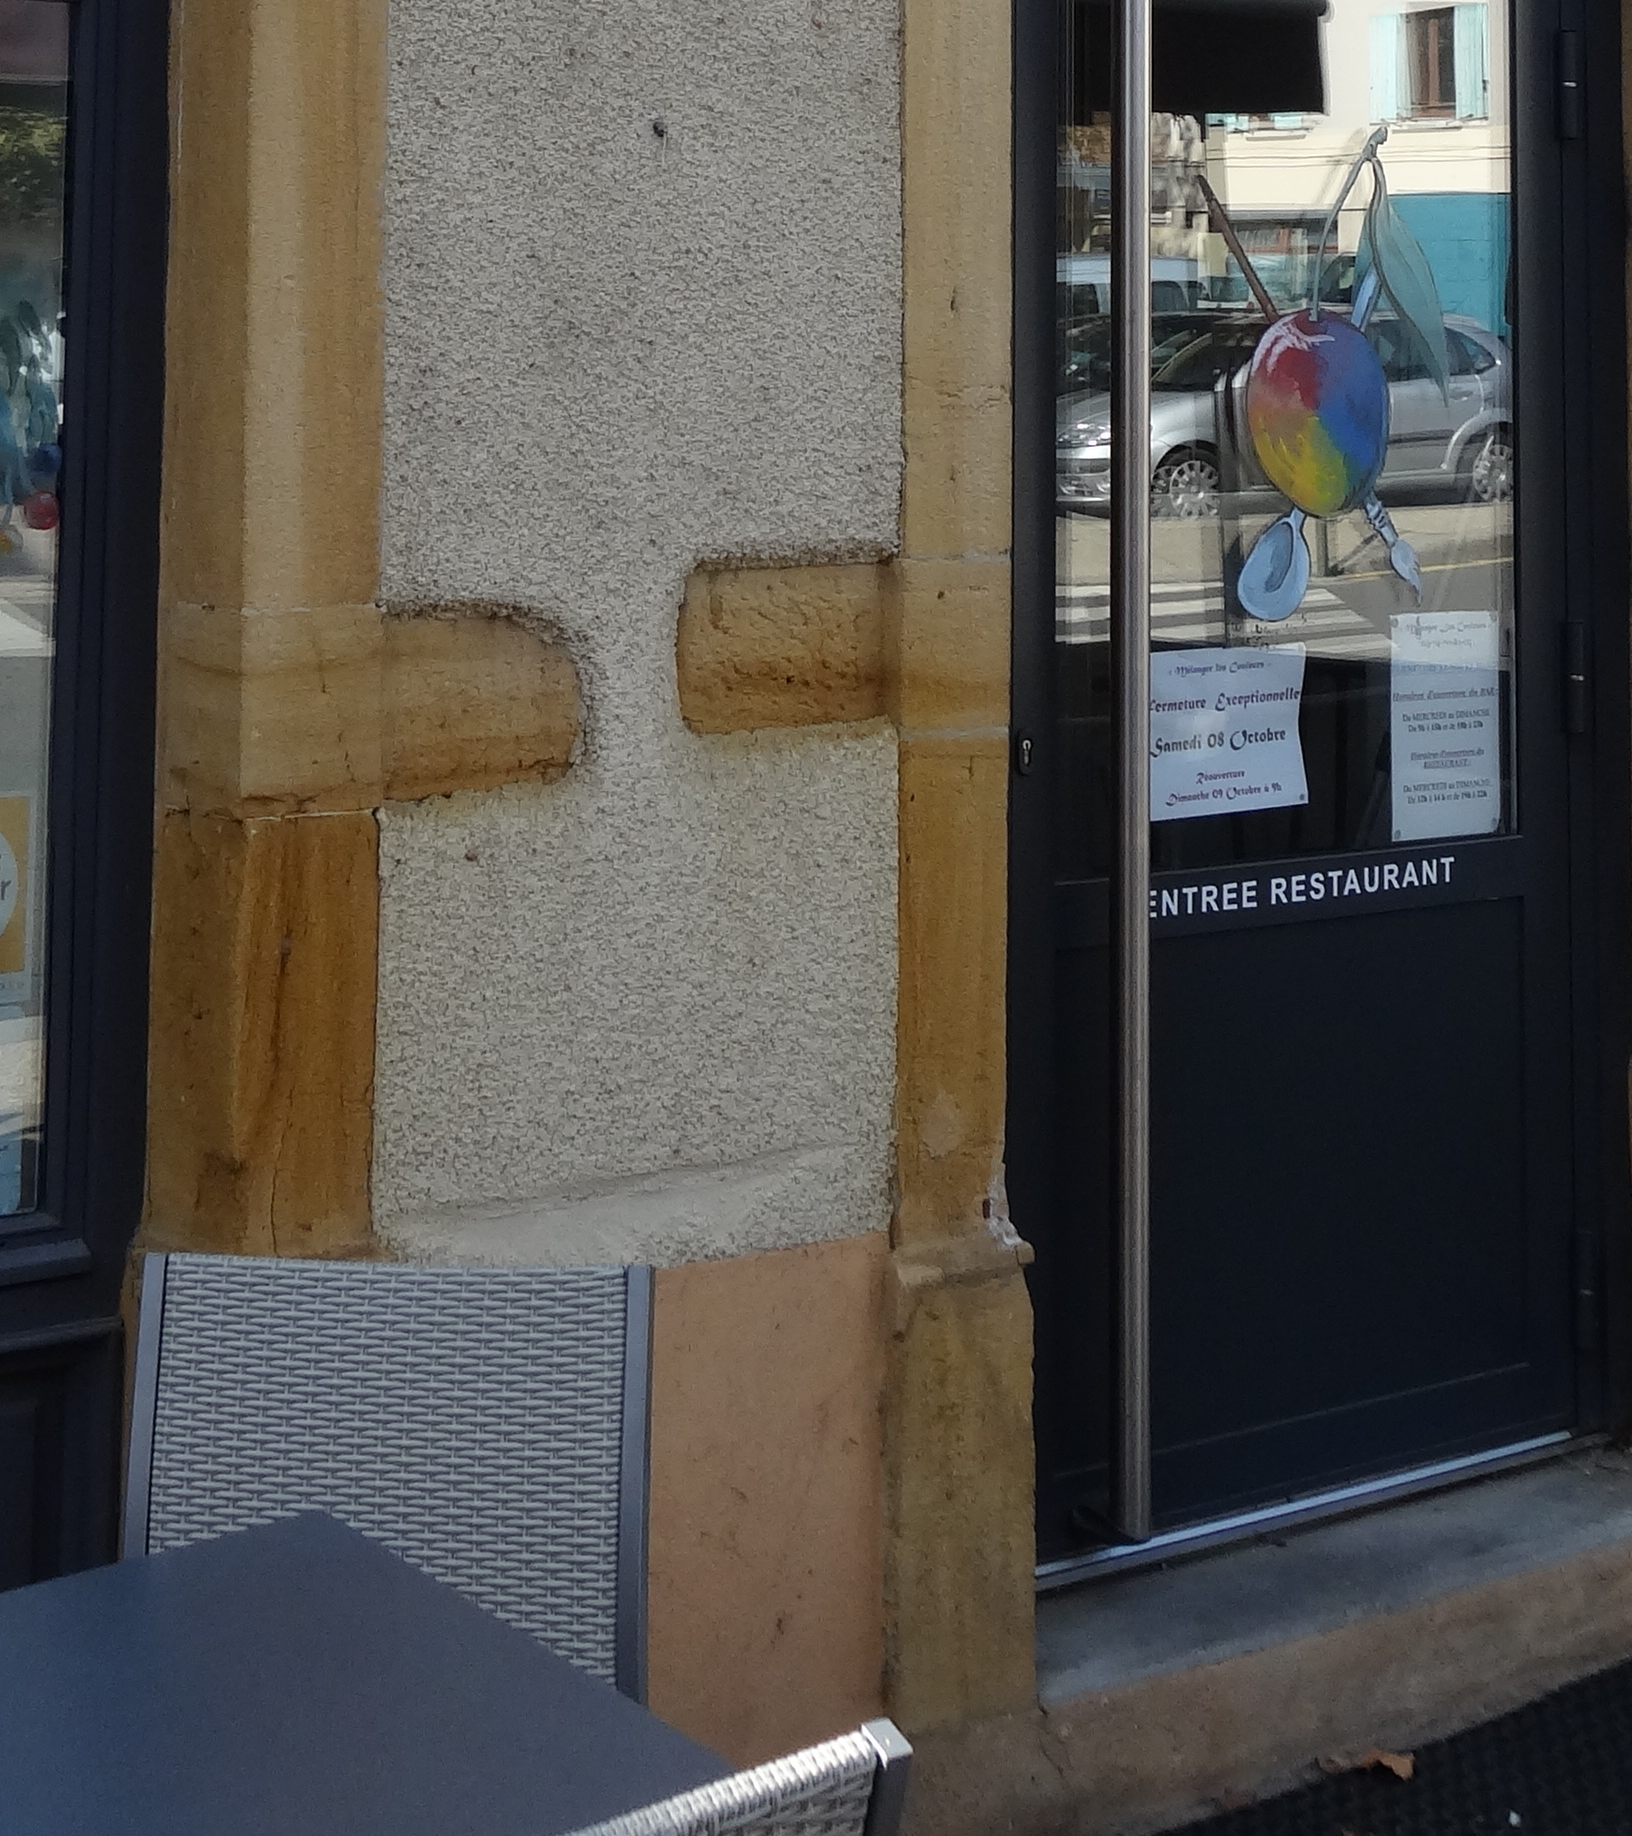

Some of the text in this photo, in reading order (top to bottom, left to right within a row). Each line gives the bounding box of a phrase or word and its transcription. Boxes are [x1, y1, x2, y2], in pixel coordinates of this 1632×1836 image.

[1215, 687, 1300, 712] Exceptionnelle
[1150, 727, 1286, 758] Samedi 08 Octobre
[1166, 791, 1210, 807] Dimanche
[1226, 785, 1262, 801] Octobre
[1270, 856, 1455, 905] RESTAURANT
